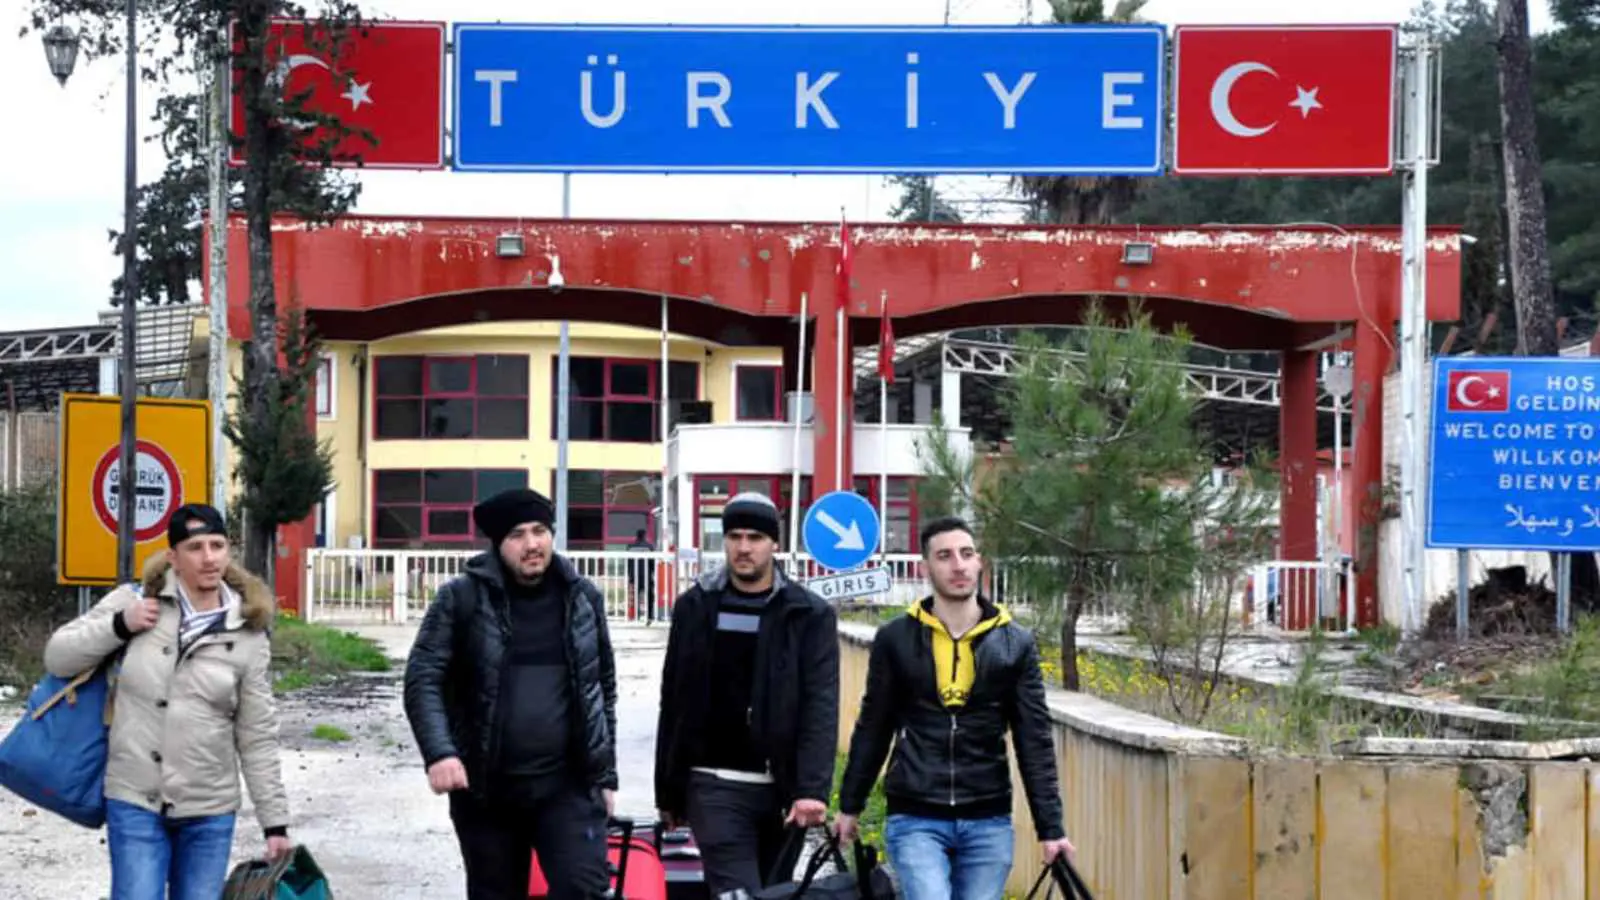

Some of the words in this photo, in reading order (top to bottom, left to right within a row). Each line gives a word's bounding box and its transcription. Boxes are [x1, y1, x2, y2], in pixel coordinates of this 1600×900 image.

[475, 53, 1144, 129] TÜRKİYE
[1444, 422, 1557, 440] WELCOME
[1564, 423, 1594, 440] TO
[108, 497, 165, 513] DANE
